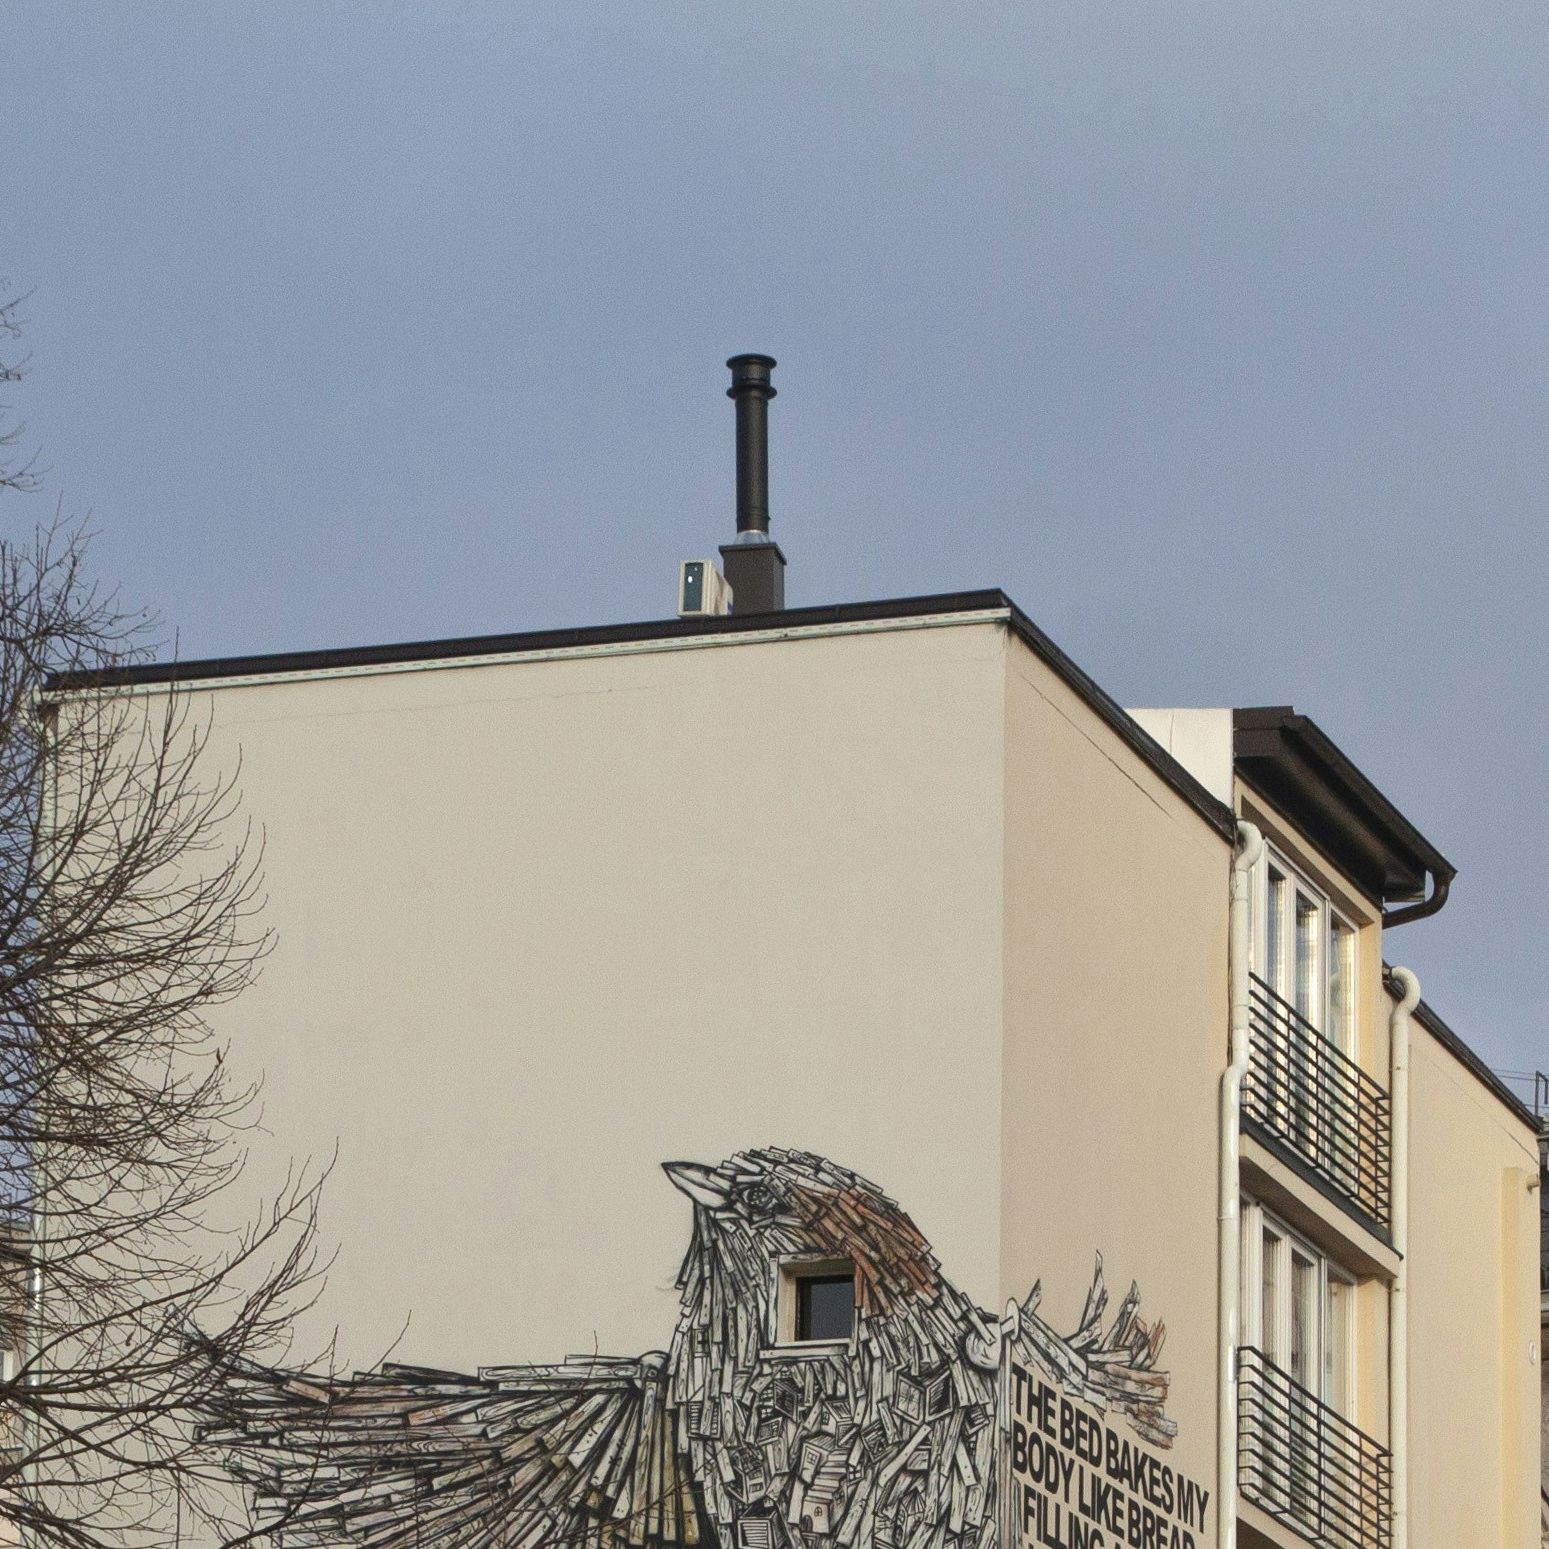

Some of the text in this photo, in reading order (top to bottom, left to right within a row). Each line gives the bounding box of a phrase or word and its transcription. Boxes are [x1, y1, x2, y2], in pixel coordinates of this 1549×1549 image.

[1012, 1362, 1209, 1534] THE BED BAKES MY
[1012, 1419, 1075, 1504] BODY
[1078, 1464, 1125, 1540] LIKE
